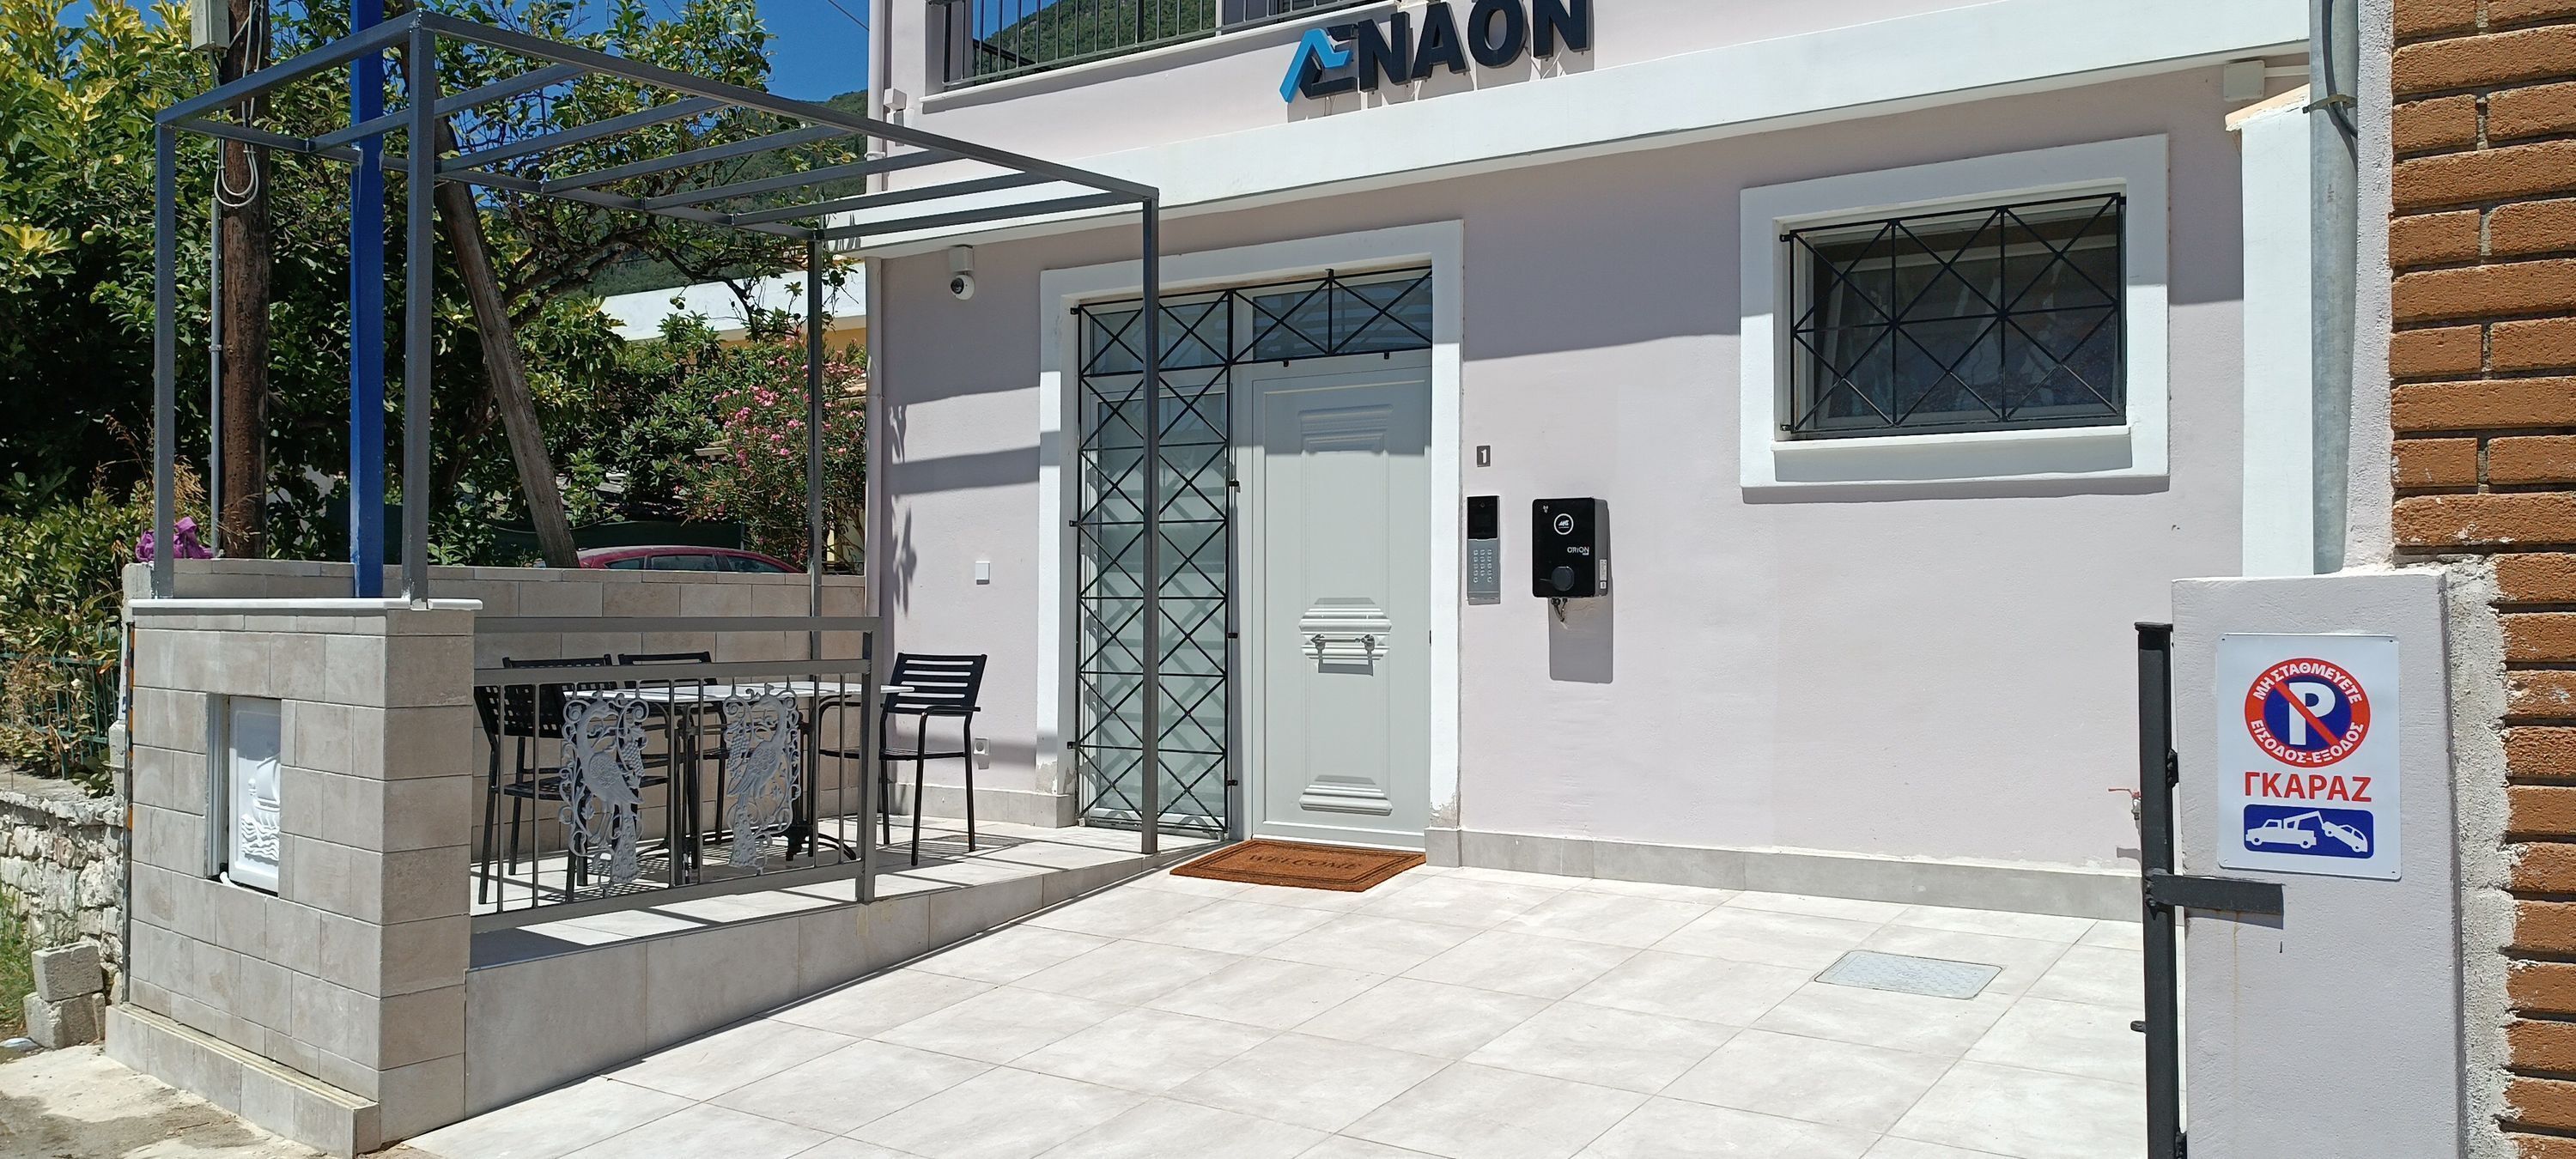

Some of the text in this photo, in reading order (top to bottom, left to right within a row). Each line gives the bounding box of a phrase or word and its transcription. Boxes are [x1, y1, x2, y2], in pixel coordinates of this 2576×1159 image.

[2253, 662, 2362, 704] ΜΗ ΣΤΑΘΜΕΥΕΤΕ
[2245, 772, 2372, 802] ΓΚΑΡΑΖ
